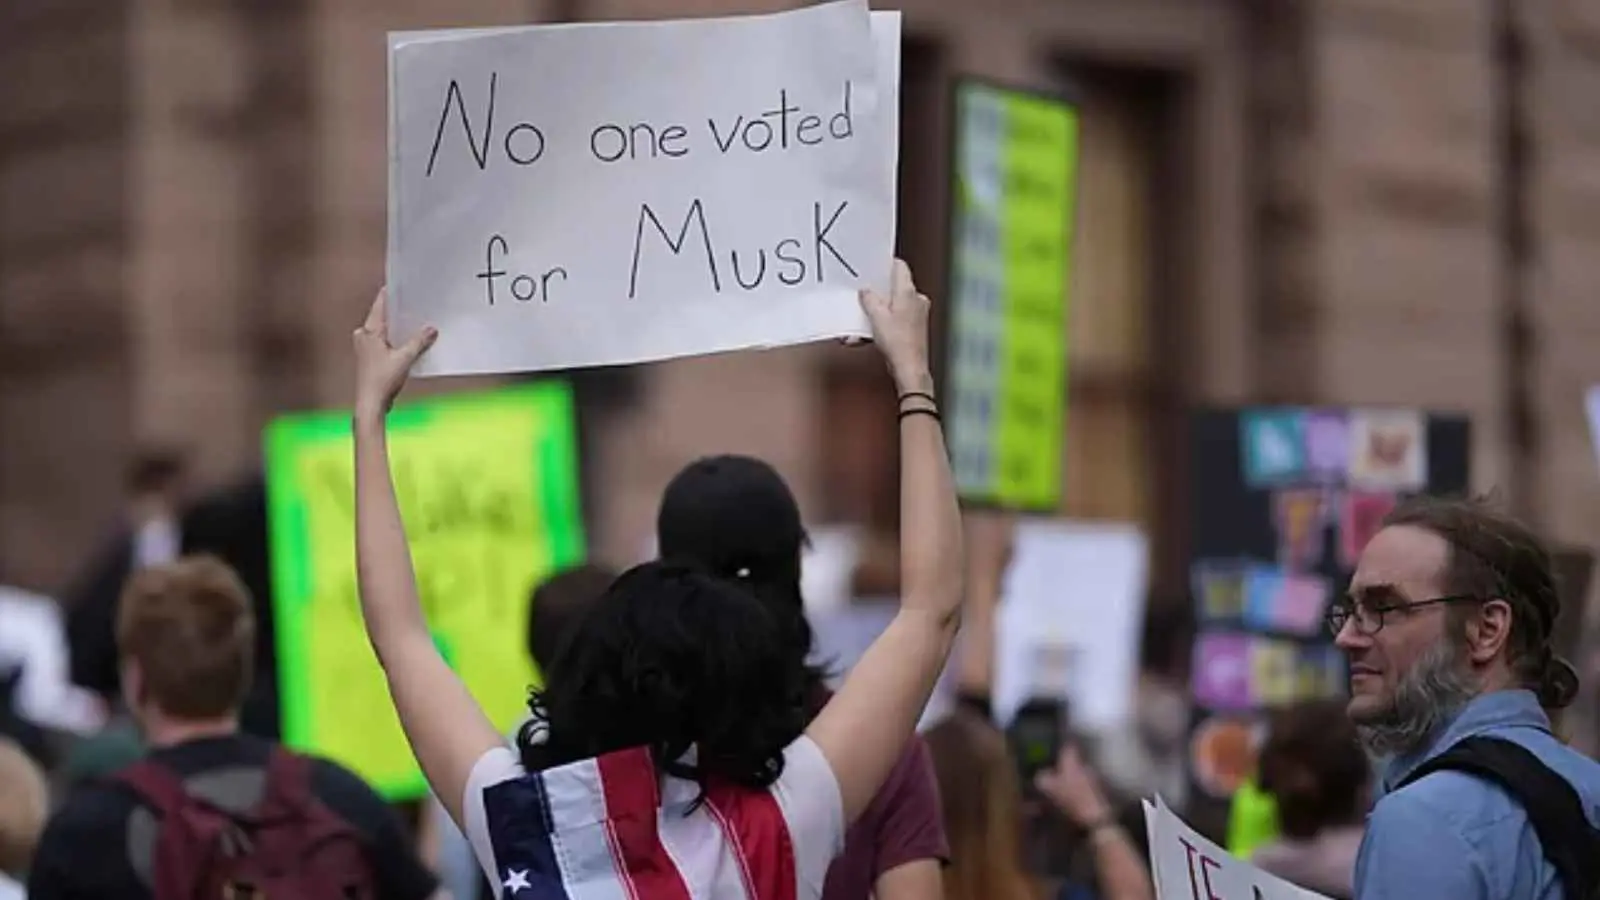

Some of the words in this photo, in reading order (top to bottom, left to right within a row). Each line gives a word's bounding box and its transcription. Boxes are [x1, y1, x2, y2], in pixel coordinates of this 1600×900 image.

[426, 72, 545, 177] No
[590, 122, 690, 162] one
[708, 80, 853, 153] voted
[476, 235, 567, 305] for
